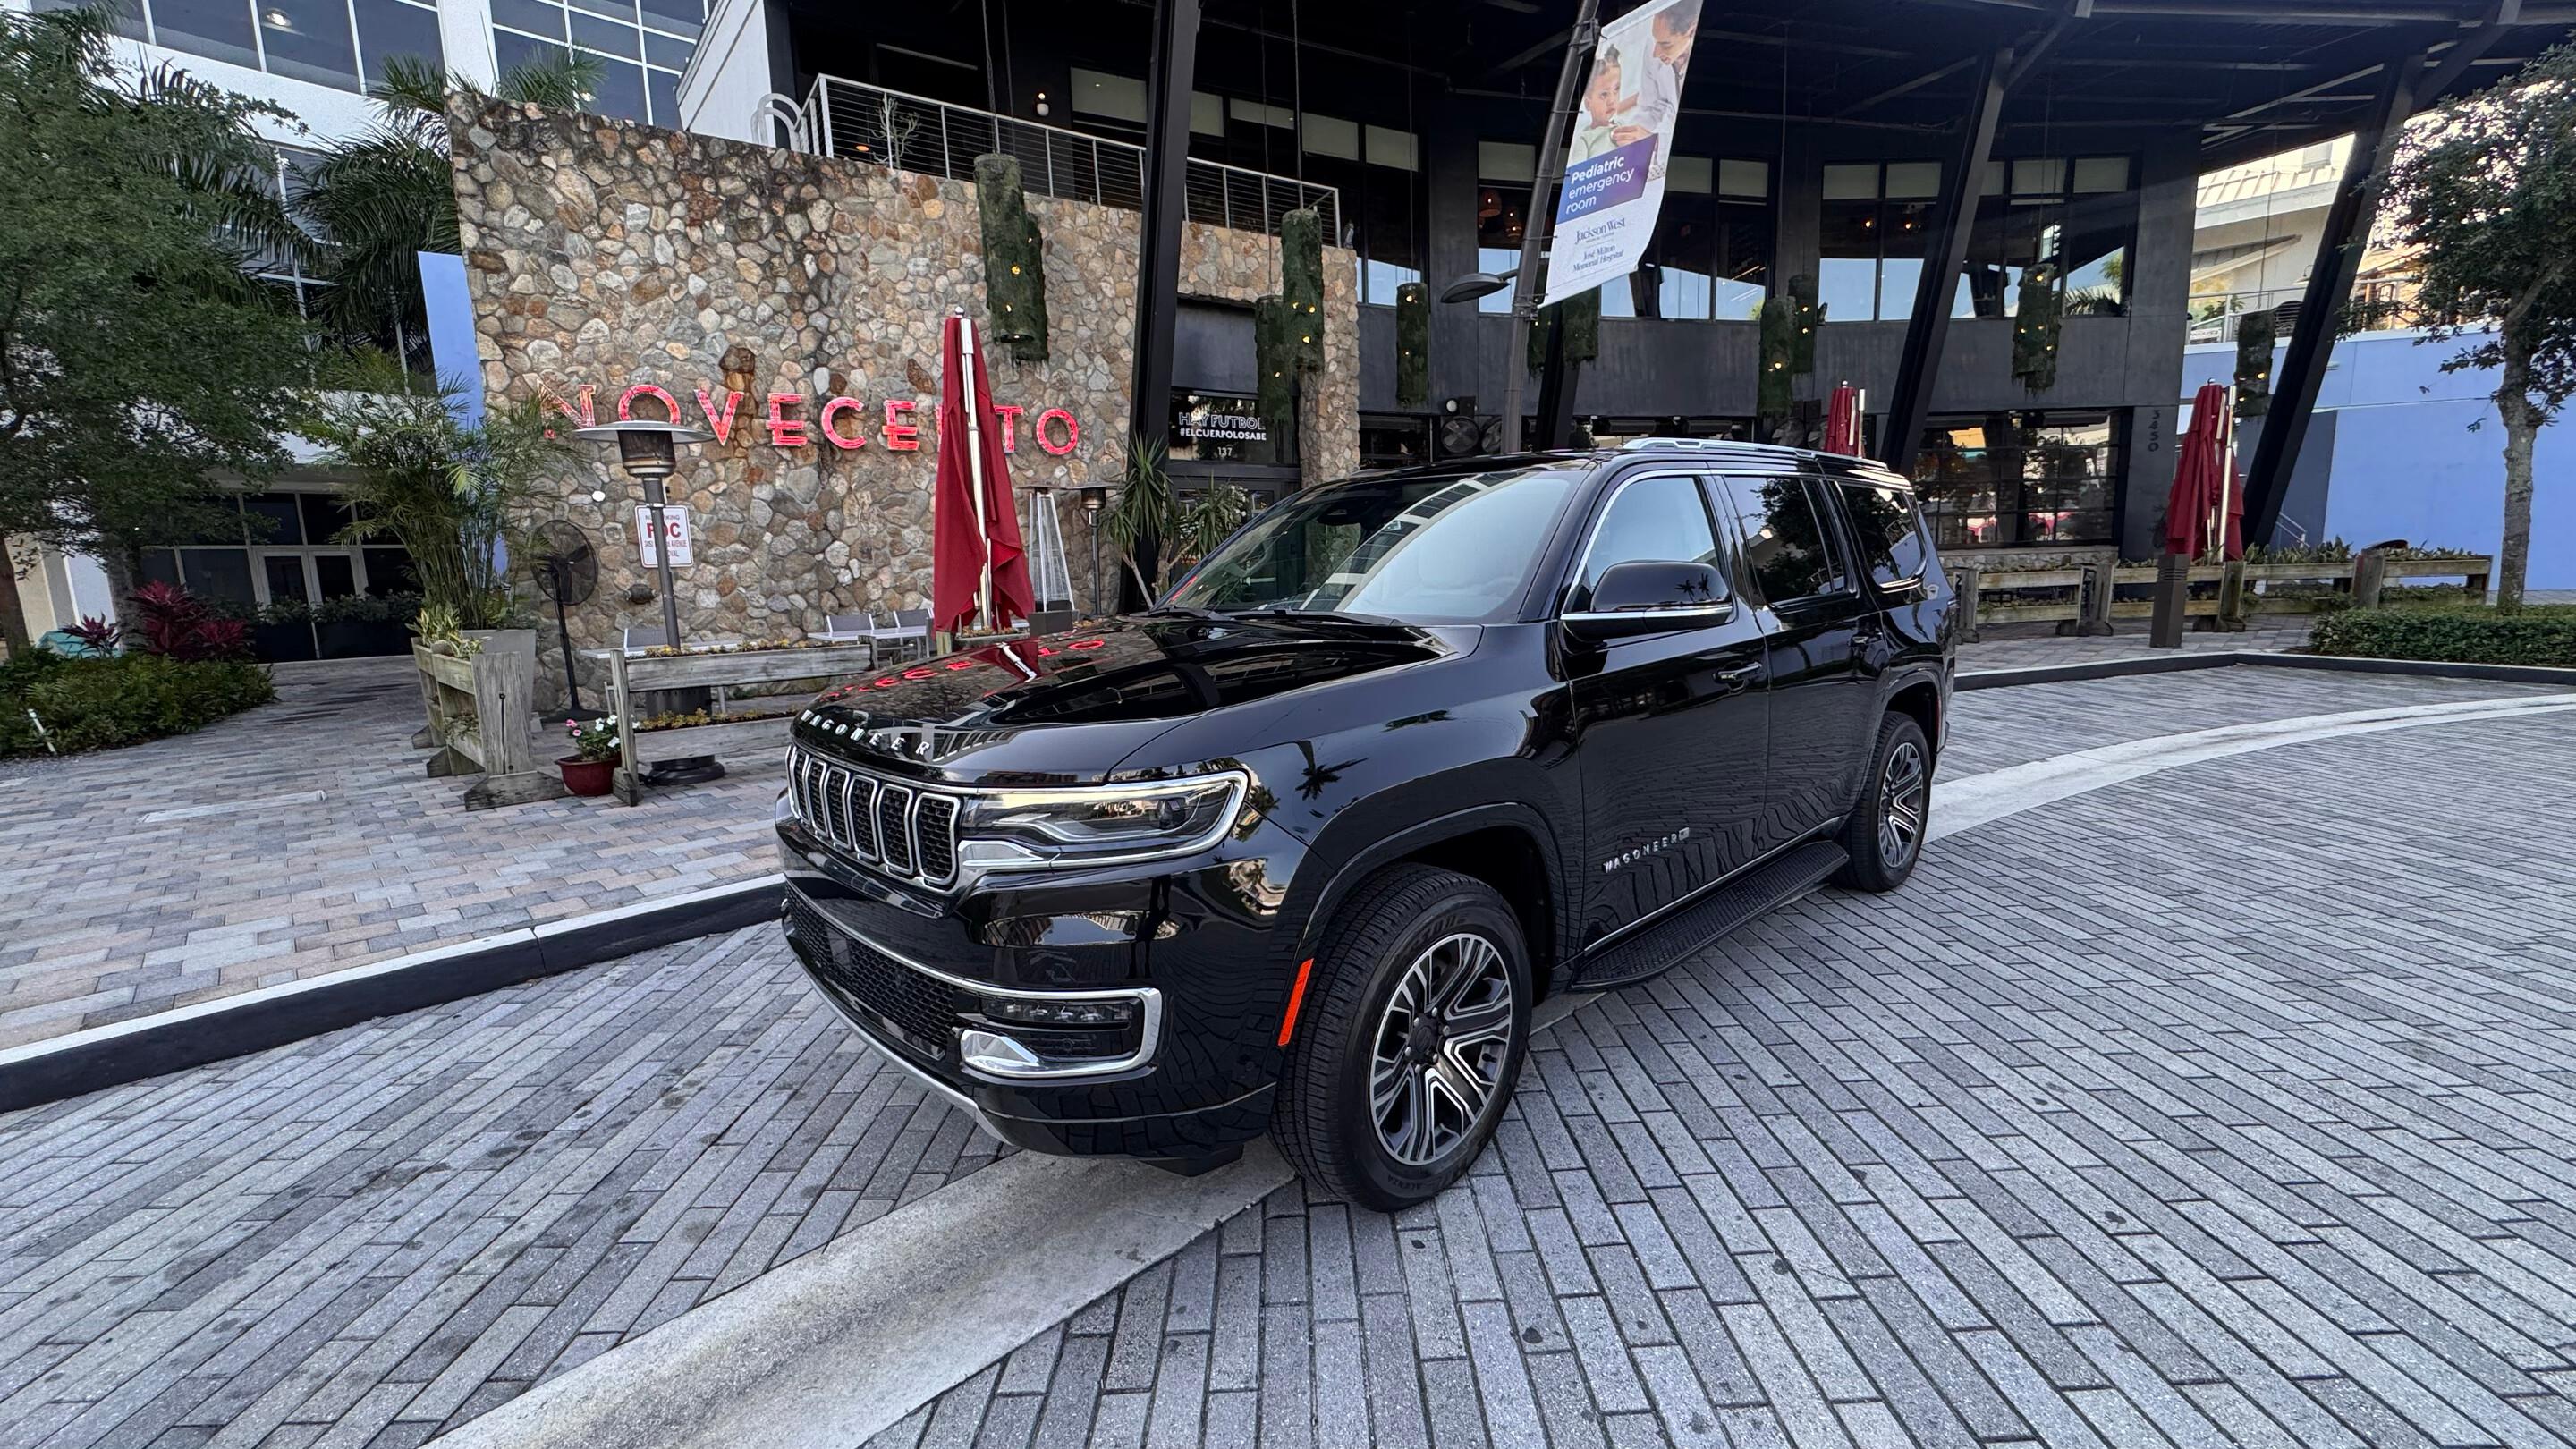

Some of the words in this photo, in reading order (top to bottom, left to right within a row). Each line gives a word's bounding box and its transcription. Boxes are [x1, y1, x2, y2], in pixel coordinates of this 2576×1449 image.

[1568, 168, 1635, 199] emergency
[1571, 156, 1624, 184] Pediatric
[1565, 196, 1597, 215] room
[1574, 225, 1606, 245] Jackson
[1606, 217, 1625, 232] West
[523, 374, 1080, 455] NOVECETO
[1210, 414, 1266, 430] FUTBOL
[1180, 428, 1267, 441] #ELCUERPOLOSABE
[1217, 446, 1233, 457] 137
[801, 709, 931, 756] WAGONEER
[1602, 834, 1677, 873] WAGONEER
